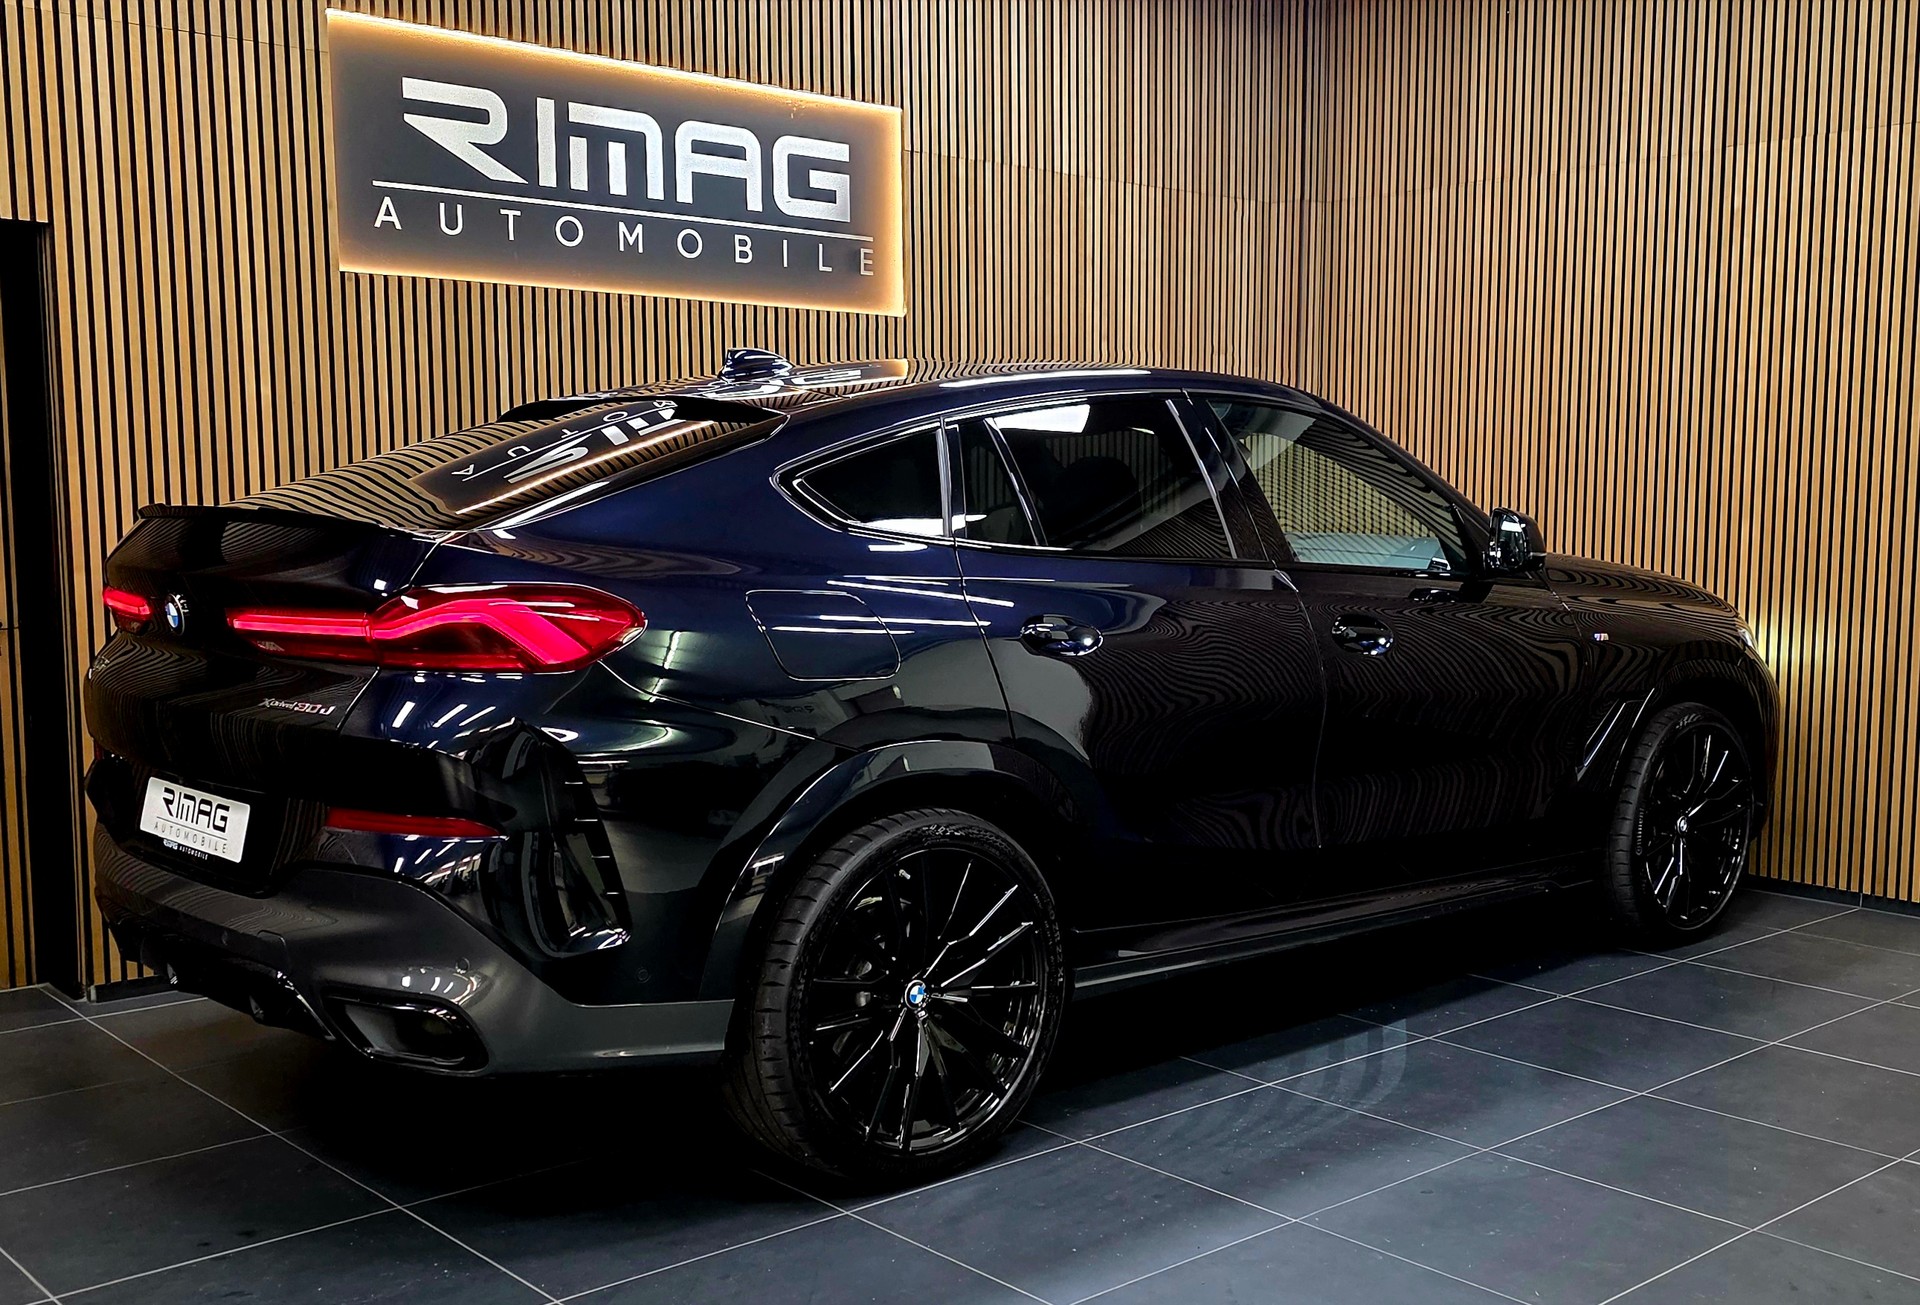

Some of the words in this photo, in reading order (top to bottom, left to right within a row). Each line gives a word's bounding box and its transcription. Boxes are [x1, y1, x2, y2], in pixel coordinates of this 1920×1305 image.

[401, 76, 851, 223] RIMAG
[373, 195, 874, 276] AUTOMOBILE
[153, 821, 228, 854] AUTOMOBILE
[162, 786, 231, 834] RIMAG
